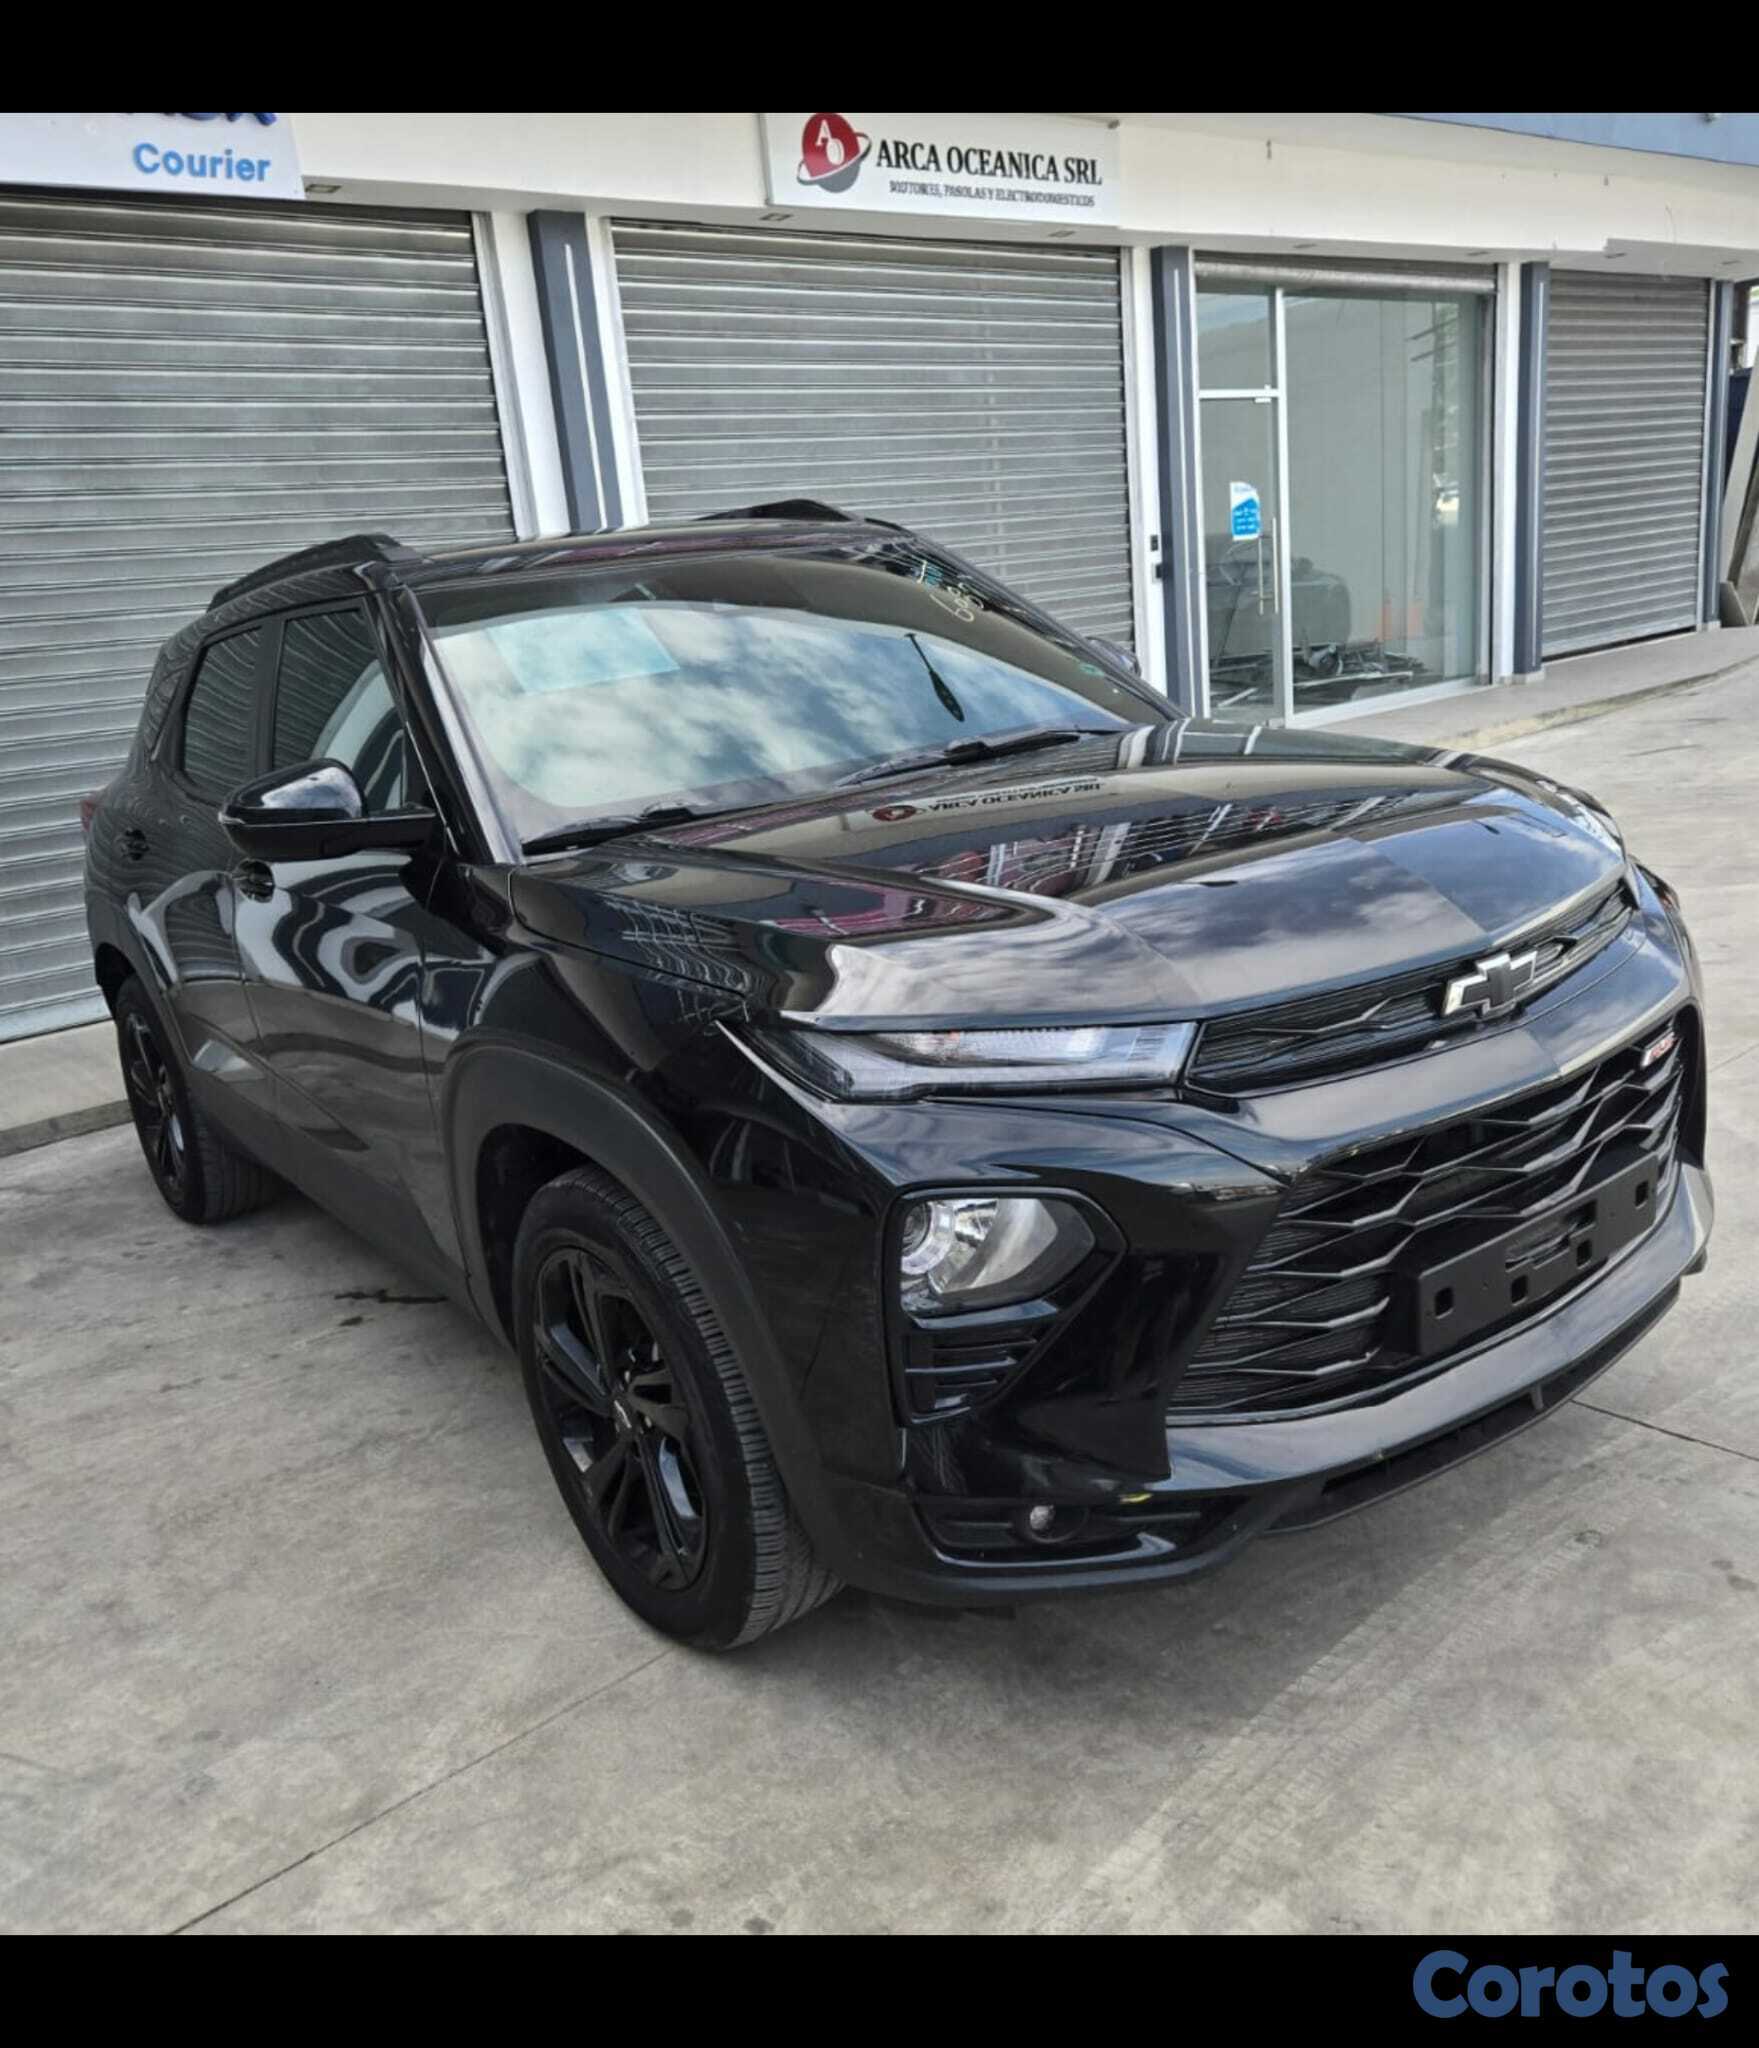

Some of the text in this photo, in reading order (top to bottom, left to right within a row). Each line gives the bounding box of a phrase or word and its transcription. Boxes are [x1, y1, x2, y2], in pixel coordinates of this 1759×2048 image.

[133, 143, 271, 182] Courier
[876, 139, 1102, 185] ARCA OCEANICA SRL
